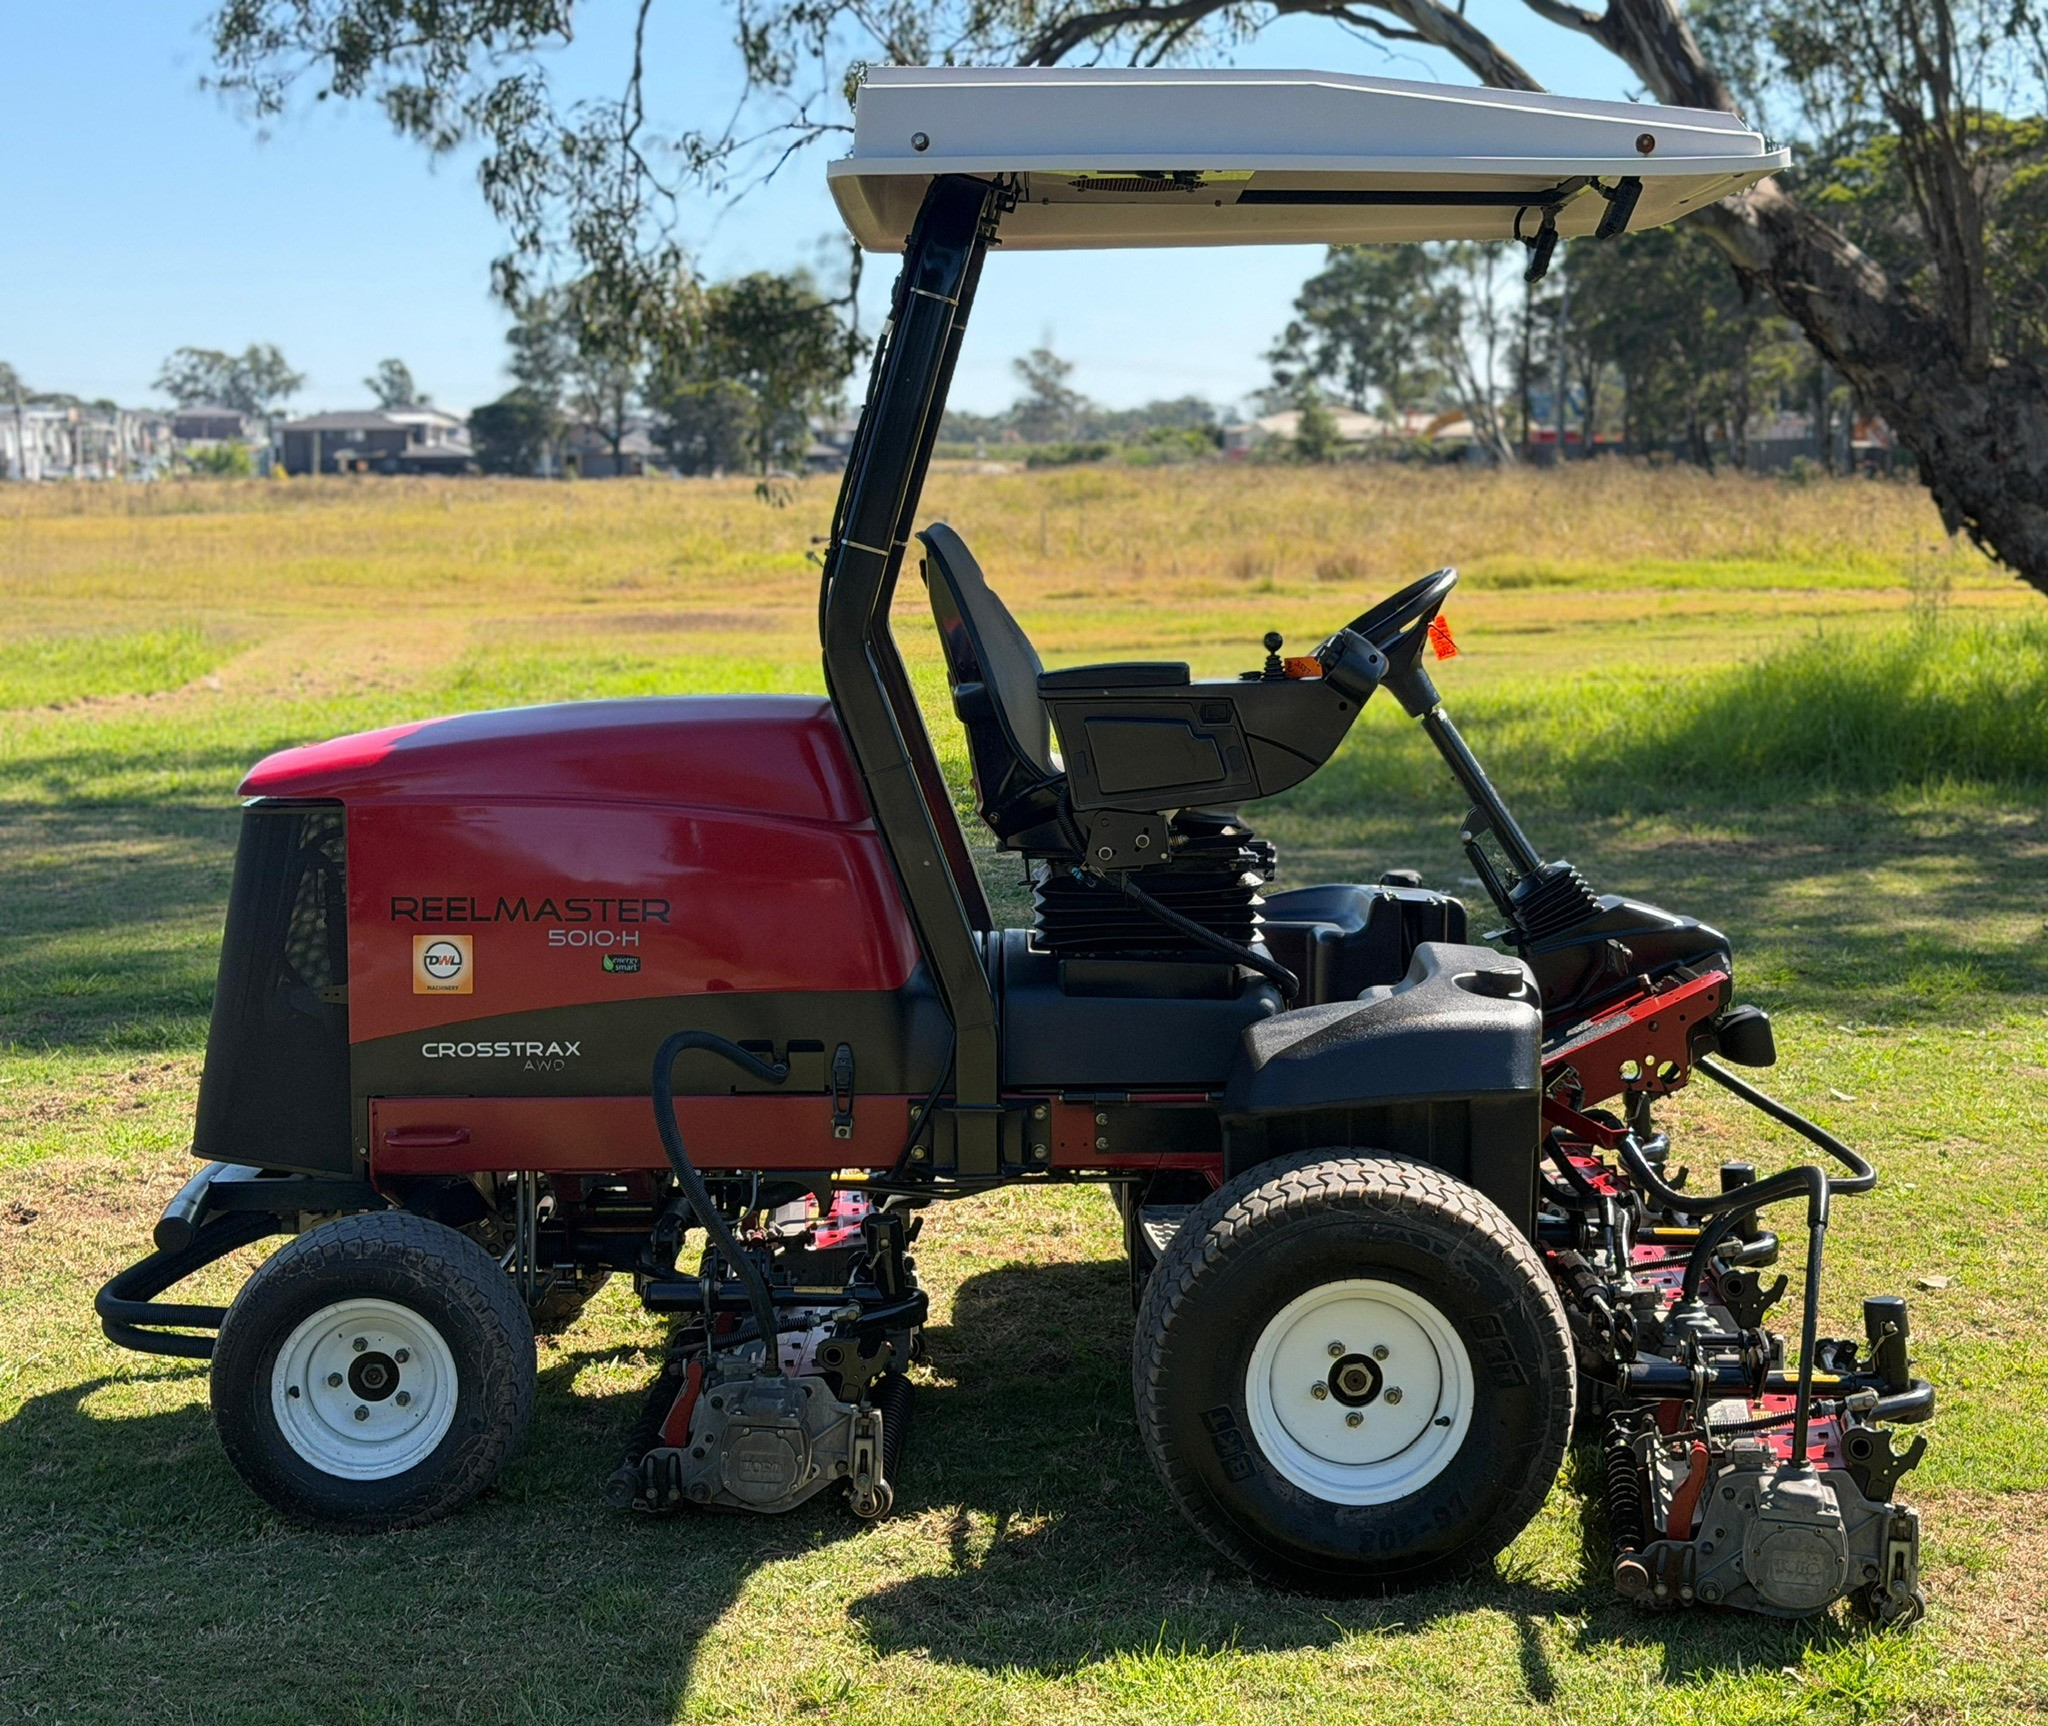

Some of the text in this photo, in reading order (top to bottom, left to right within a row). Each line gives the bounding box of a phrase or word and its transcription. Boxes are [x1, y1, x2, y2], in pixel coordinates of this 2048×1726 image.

[391, 896, 671, 924] REELMASTER
[612, 957, 639, 966] energy
[615, 963, 638, 971] smart
[421, 1041, 582, 1058] CROSSTRAX
[523, 1059, 566, 1072] AWD
